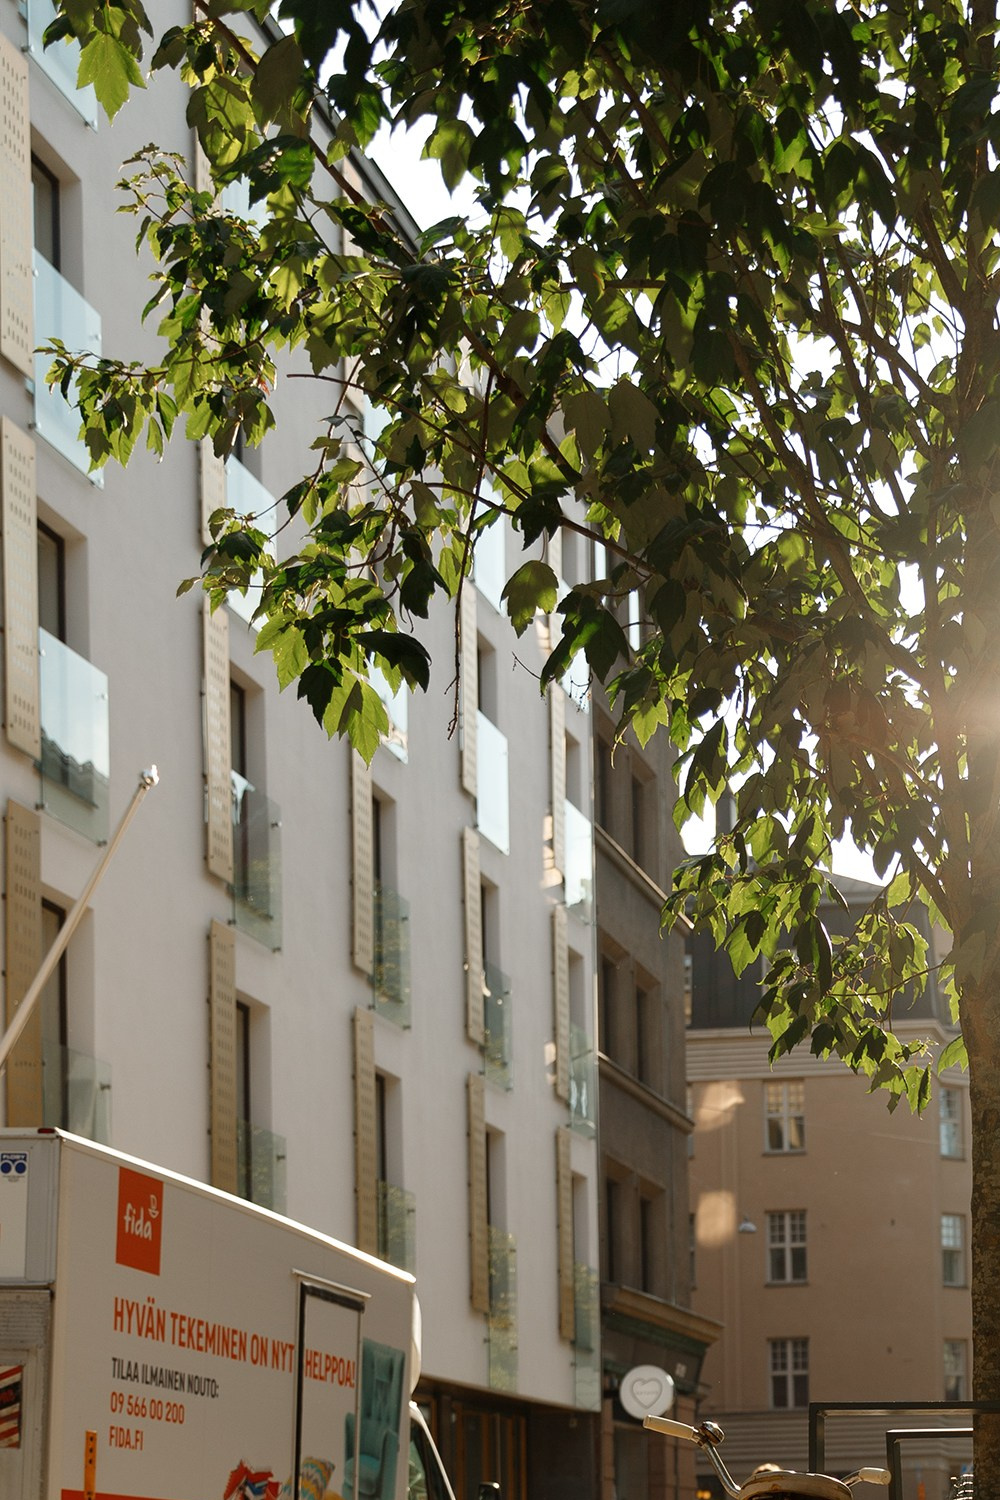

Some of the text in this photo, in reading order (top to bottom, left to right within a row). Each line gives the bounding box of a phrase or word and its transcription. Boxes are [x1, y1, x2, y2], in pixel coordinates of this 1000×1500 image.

[123, 1202, 153, 1241] fida
[113, 1296, 356, 1388] HYVÄN TEKEMINEN ON NYT HELPPOA!
[111, 1357, 219, 1399] TILAA ILMAINEN NOUTO:
[110, 1391, 185, 1425] 09 566 00 200
[108, 1425, 144, 1451] FIDA.FI
